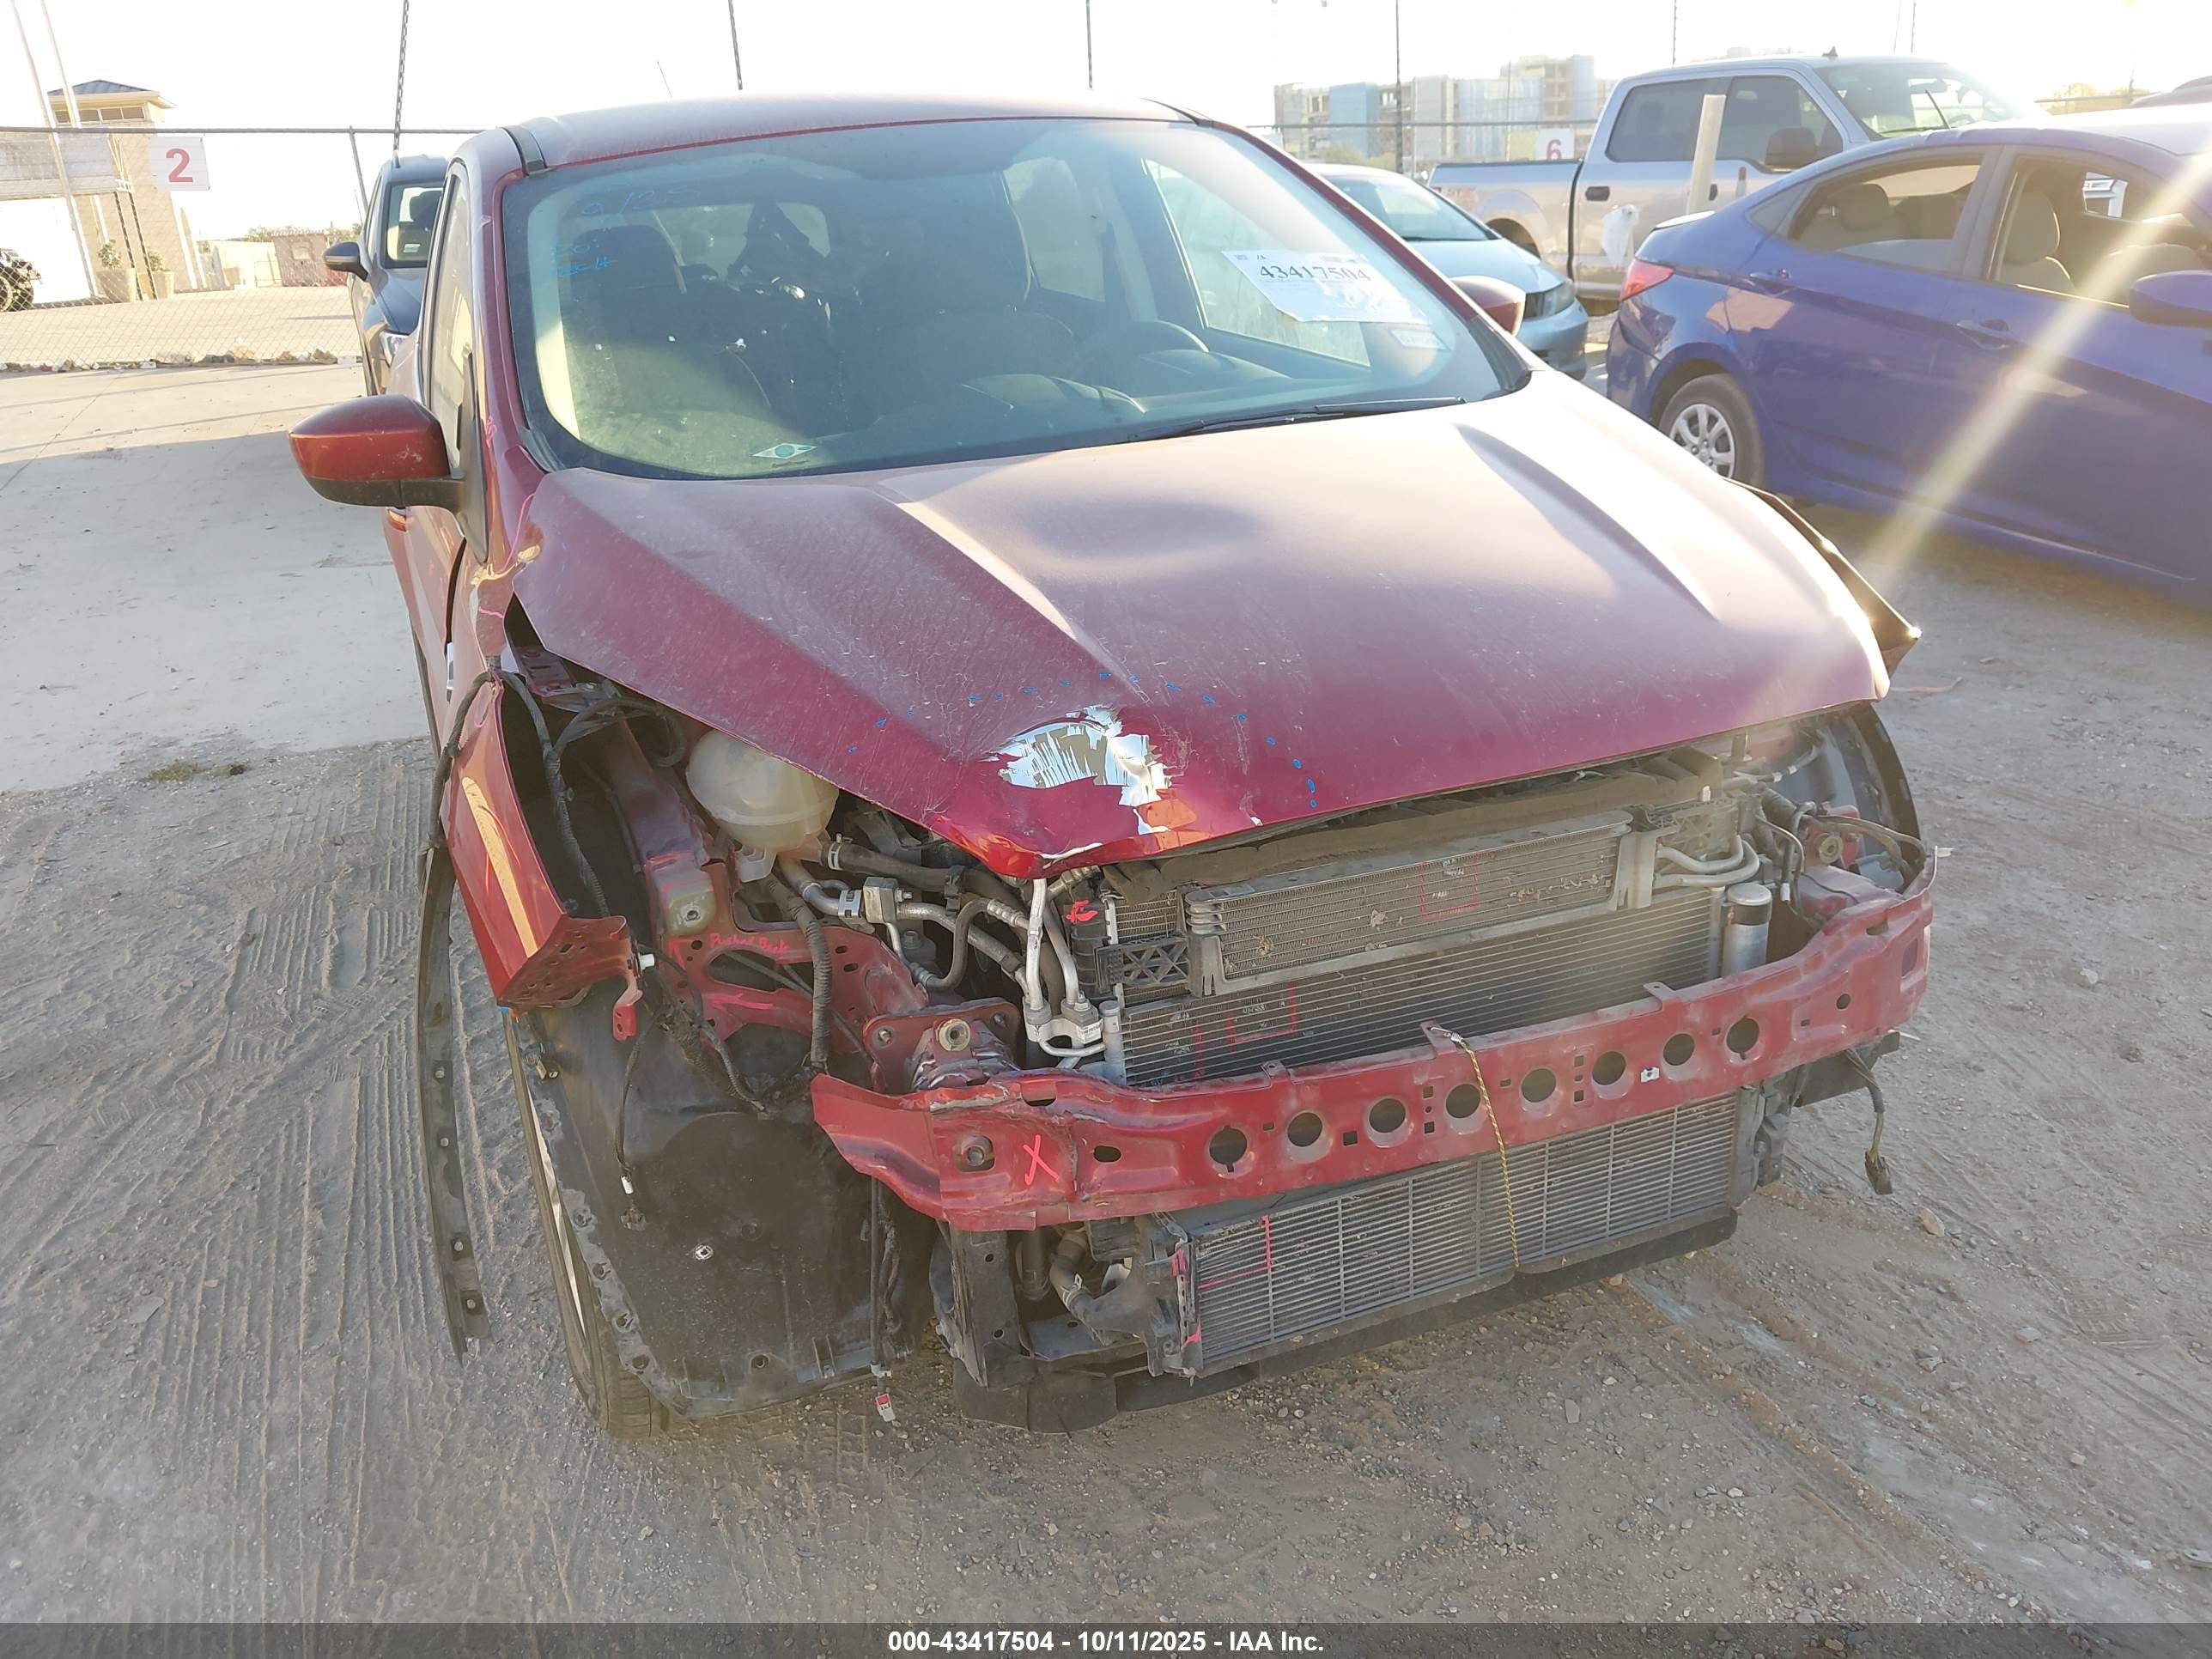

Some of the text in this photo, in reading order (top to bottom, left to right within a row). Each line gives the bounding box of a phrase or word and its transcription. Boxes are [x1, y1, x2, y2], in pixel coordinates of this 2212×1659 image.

[1547, 139, 1562, 161] 6
[166, 149, 193, 182] 2
[1260, 265, 1371, 281] 43417504
